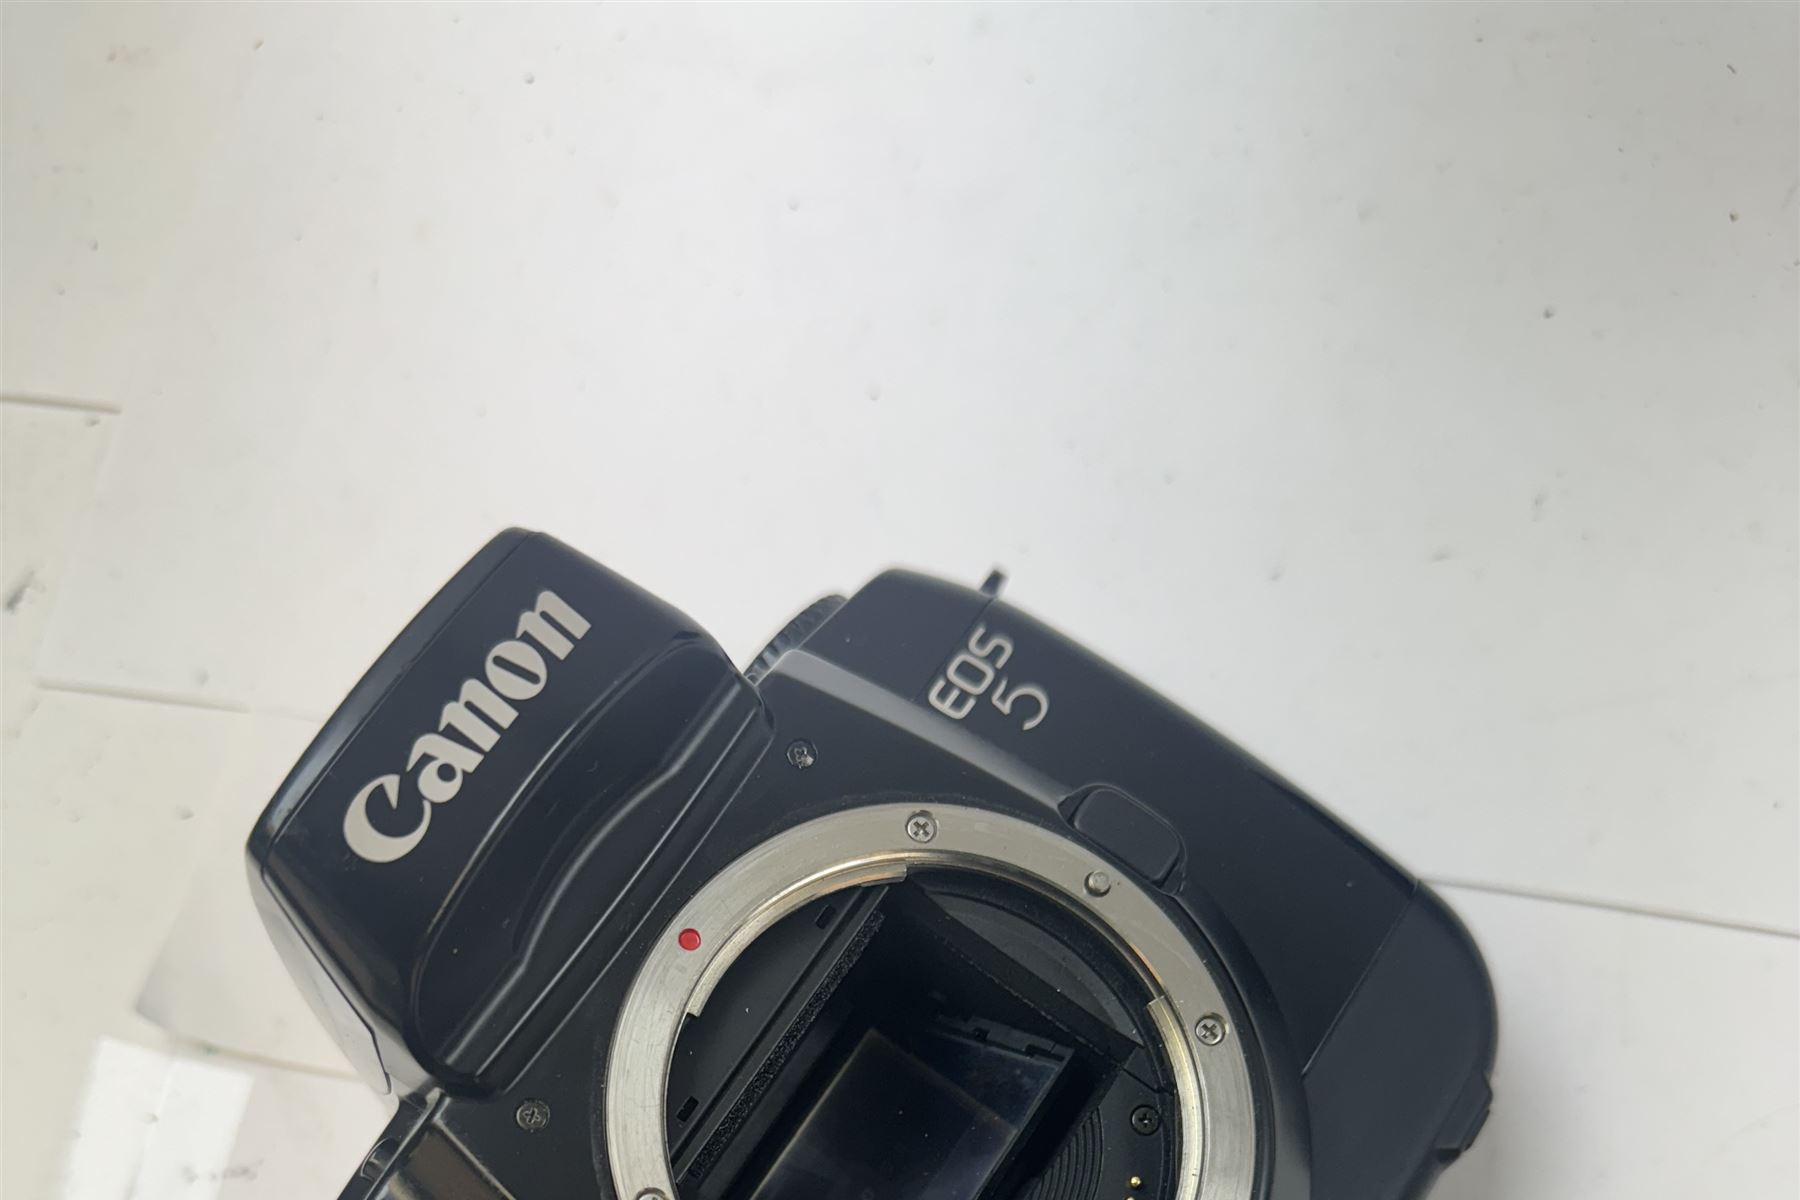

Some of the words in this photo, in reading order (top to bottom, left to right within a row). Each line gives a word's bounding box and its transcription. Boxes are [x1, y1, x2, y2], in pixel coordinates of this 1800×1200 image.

[927, 623, 1013, 720] EOS
[991, 677, 1048, 731] 5
[343, 590, 592, 863] Canon
